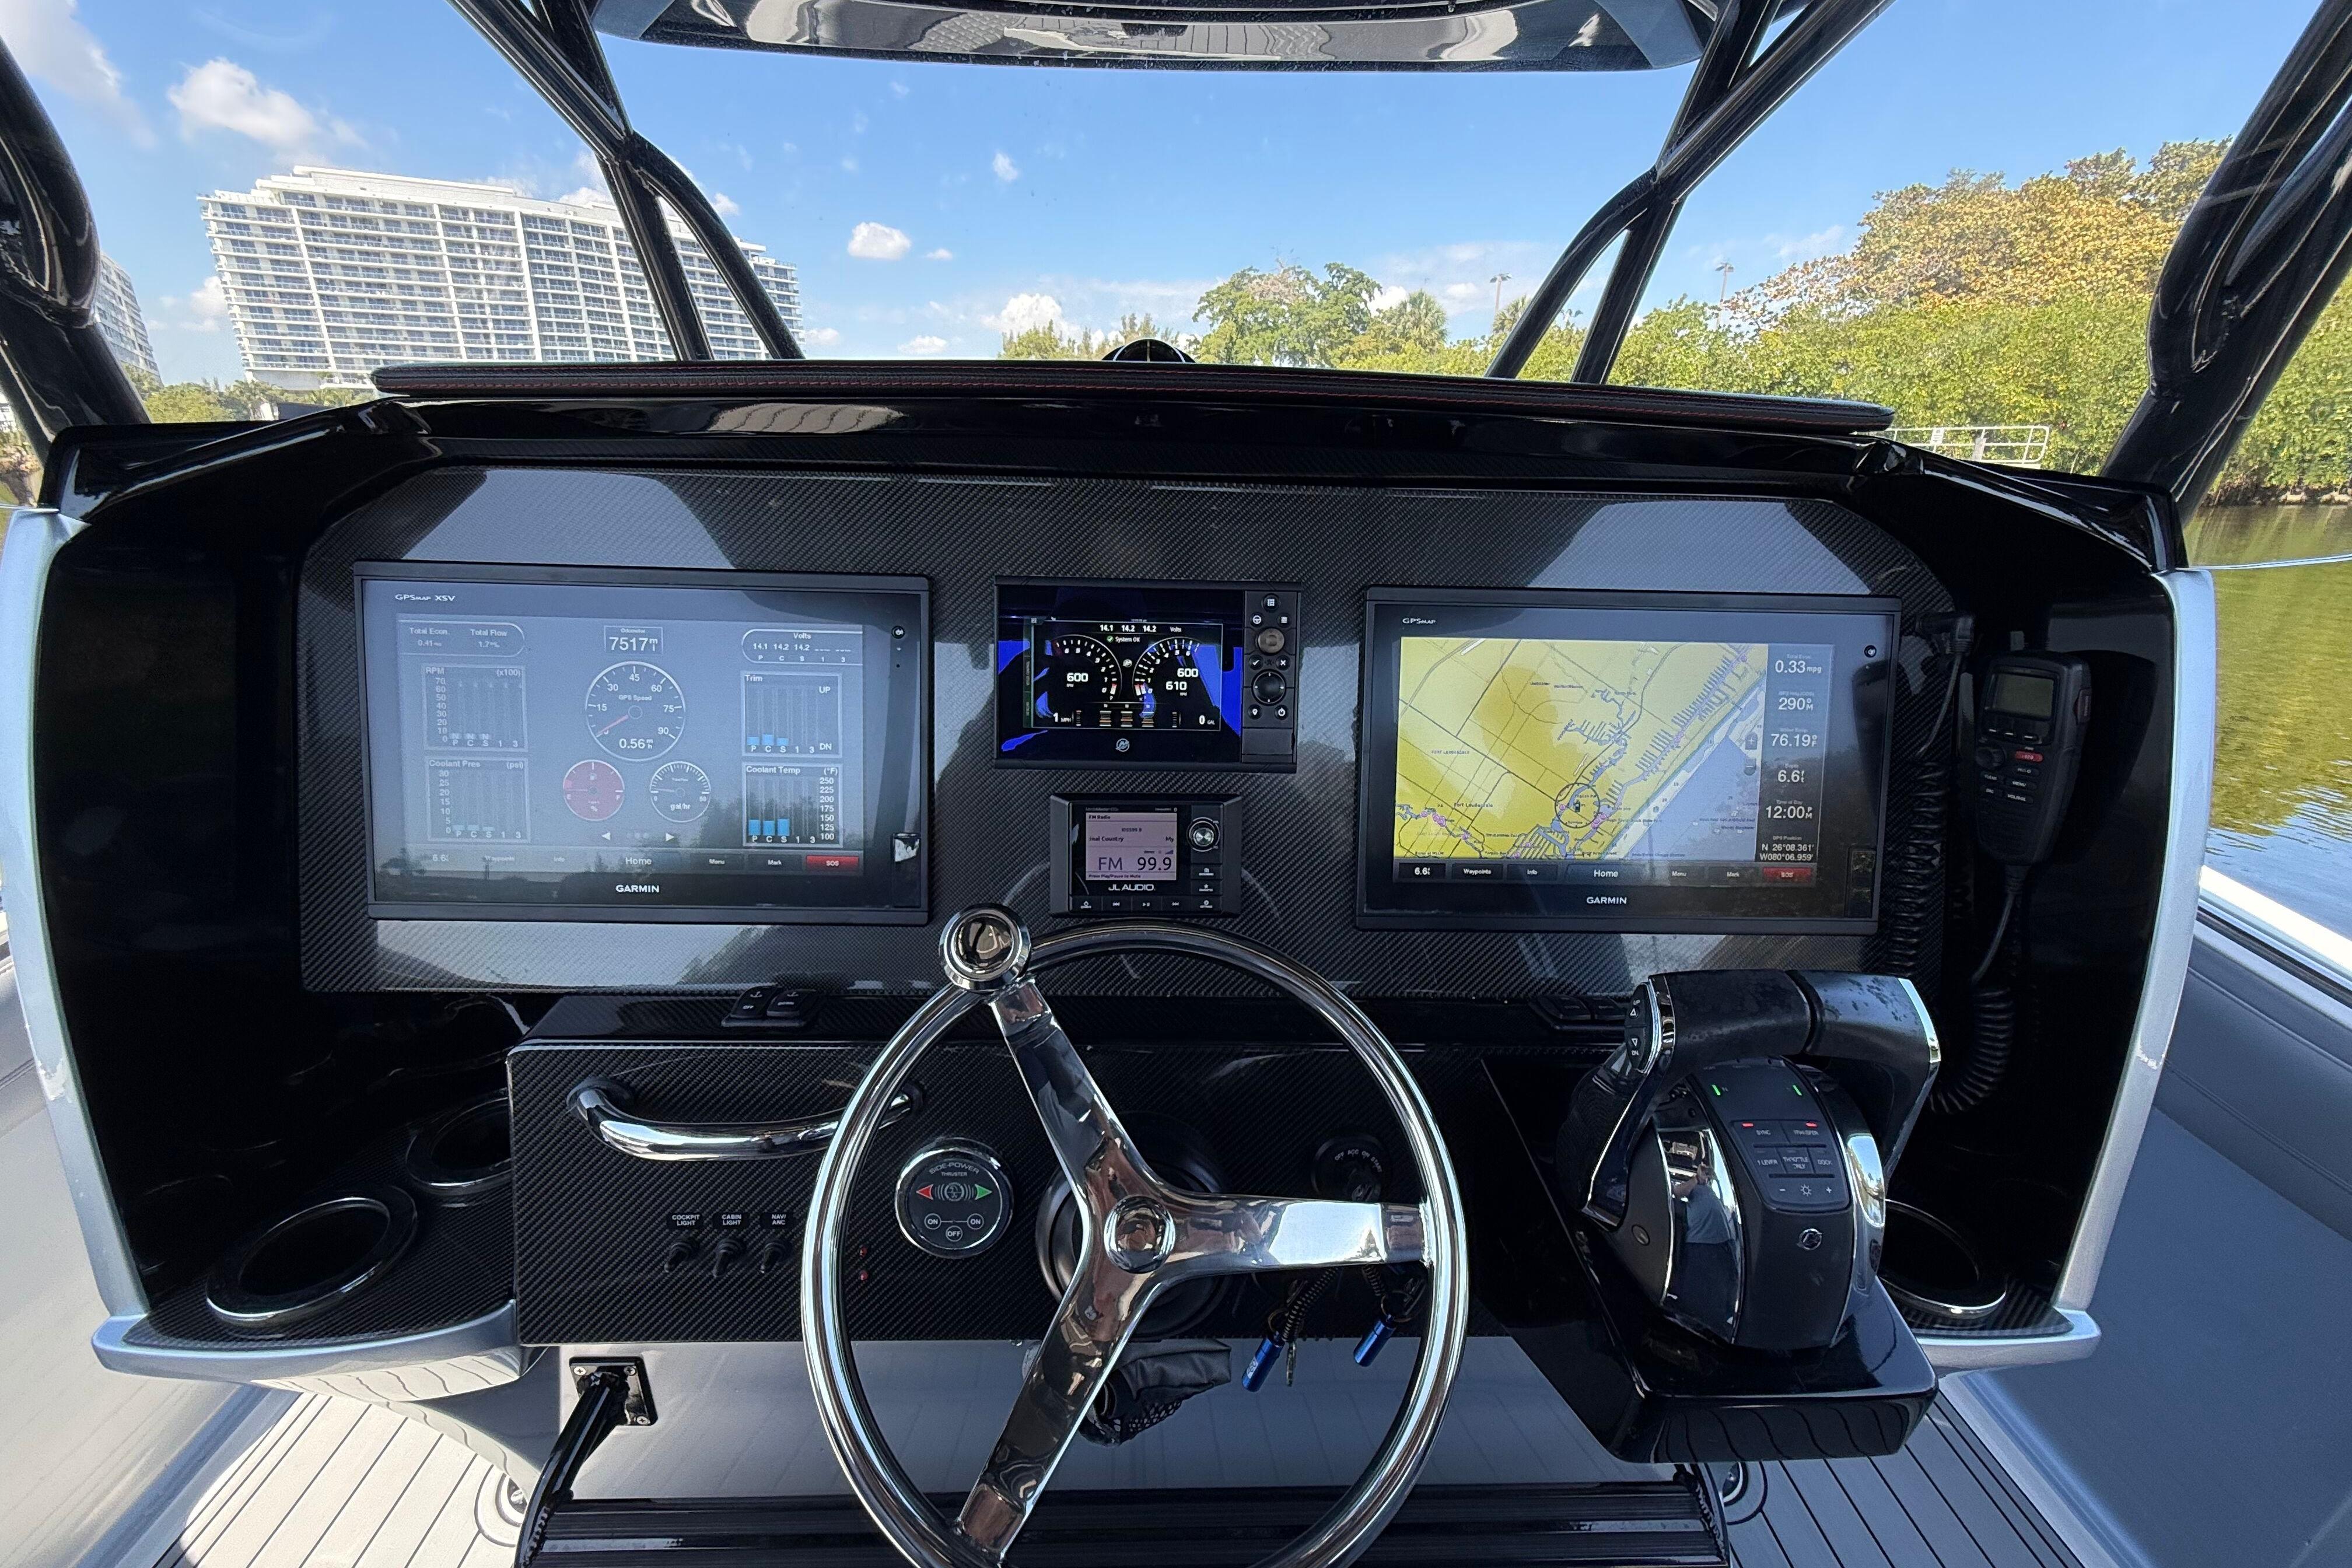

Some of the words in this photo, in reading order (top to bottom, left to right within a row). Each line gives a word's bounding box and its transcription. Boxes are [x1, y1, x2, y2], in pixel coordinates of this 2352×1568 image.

[609, 637, 648, 651] 7517
[1775, 660, 1805, 673] 0.33
[496, 669, 521, 677] (x100)
[1067, 673, 1088, 682] 600
[1177, 668, 1199, 677] 600
[1166, 681, 1187, 691] 610
[1778, 698, 1805, 710] 290
[1199, 715, 1205, 724] 0
[619, 738, 645, 749] 0.56
[1771, 734, 1811, 747] 76.19
[429, 760, 461, 768] Coolant
[506, 761, 524, 770] (psi)
[746, 766, 776, 774] Coolant
[778, 766, 800, 775] Temp
[1778, 769, 1800, 783] 6.6
[1766, 806, 1805, 819] 12:00
[1098, 858, 1122, 870] FM
[1138, 857, 1172, 871] 99.9
[1594, 869, 1619, 877] Home
[615, 885, 660, 893] GARMIN
[1586, 897, 1628, 905] GARMIN
[929, 1161, 980, 1175] SIDE-POWER
[1371, 1156, 1382, 1172] START
